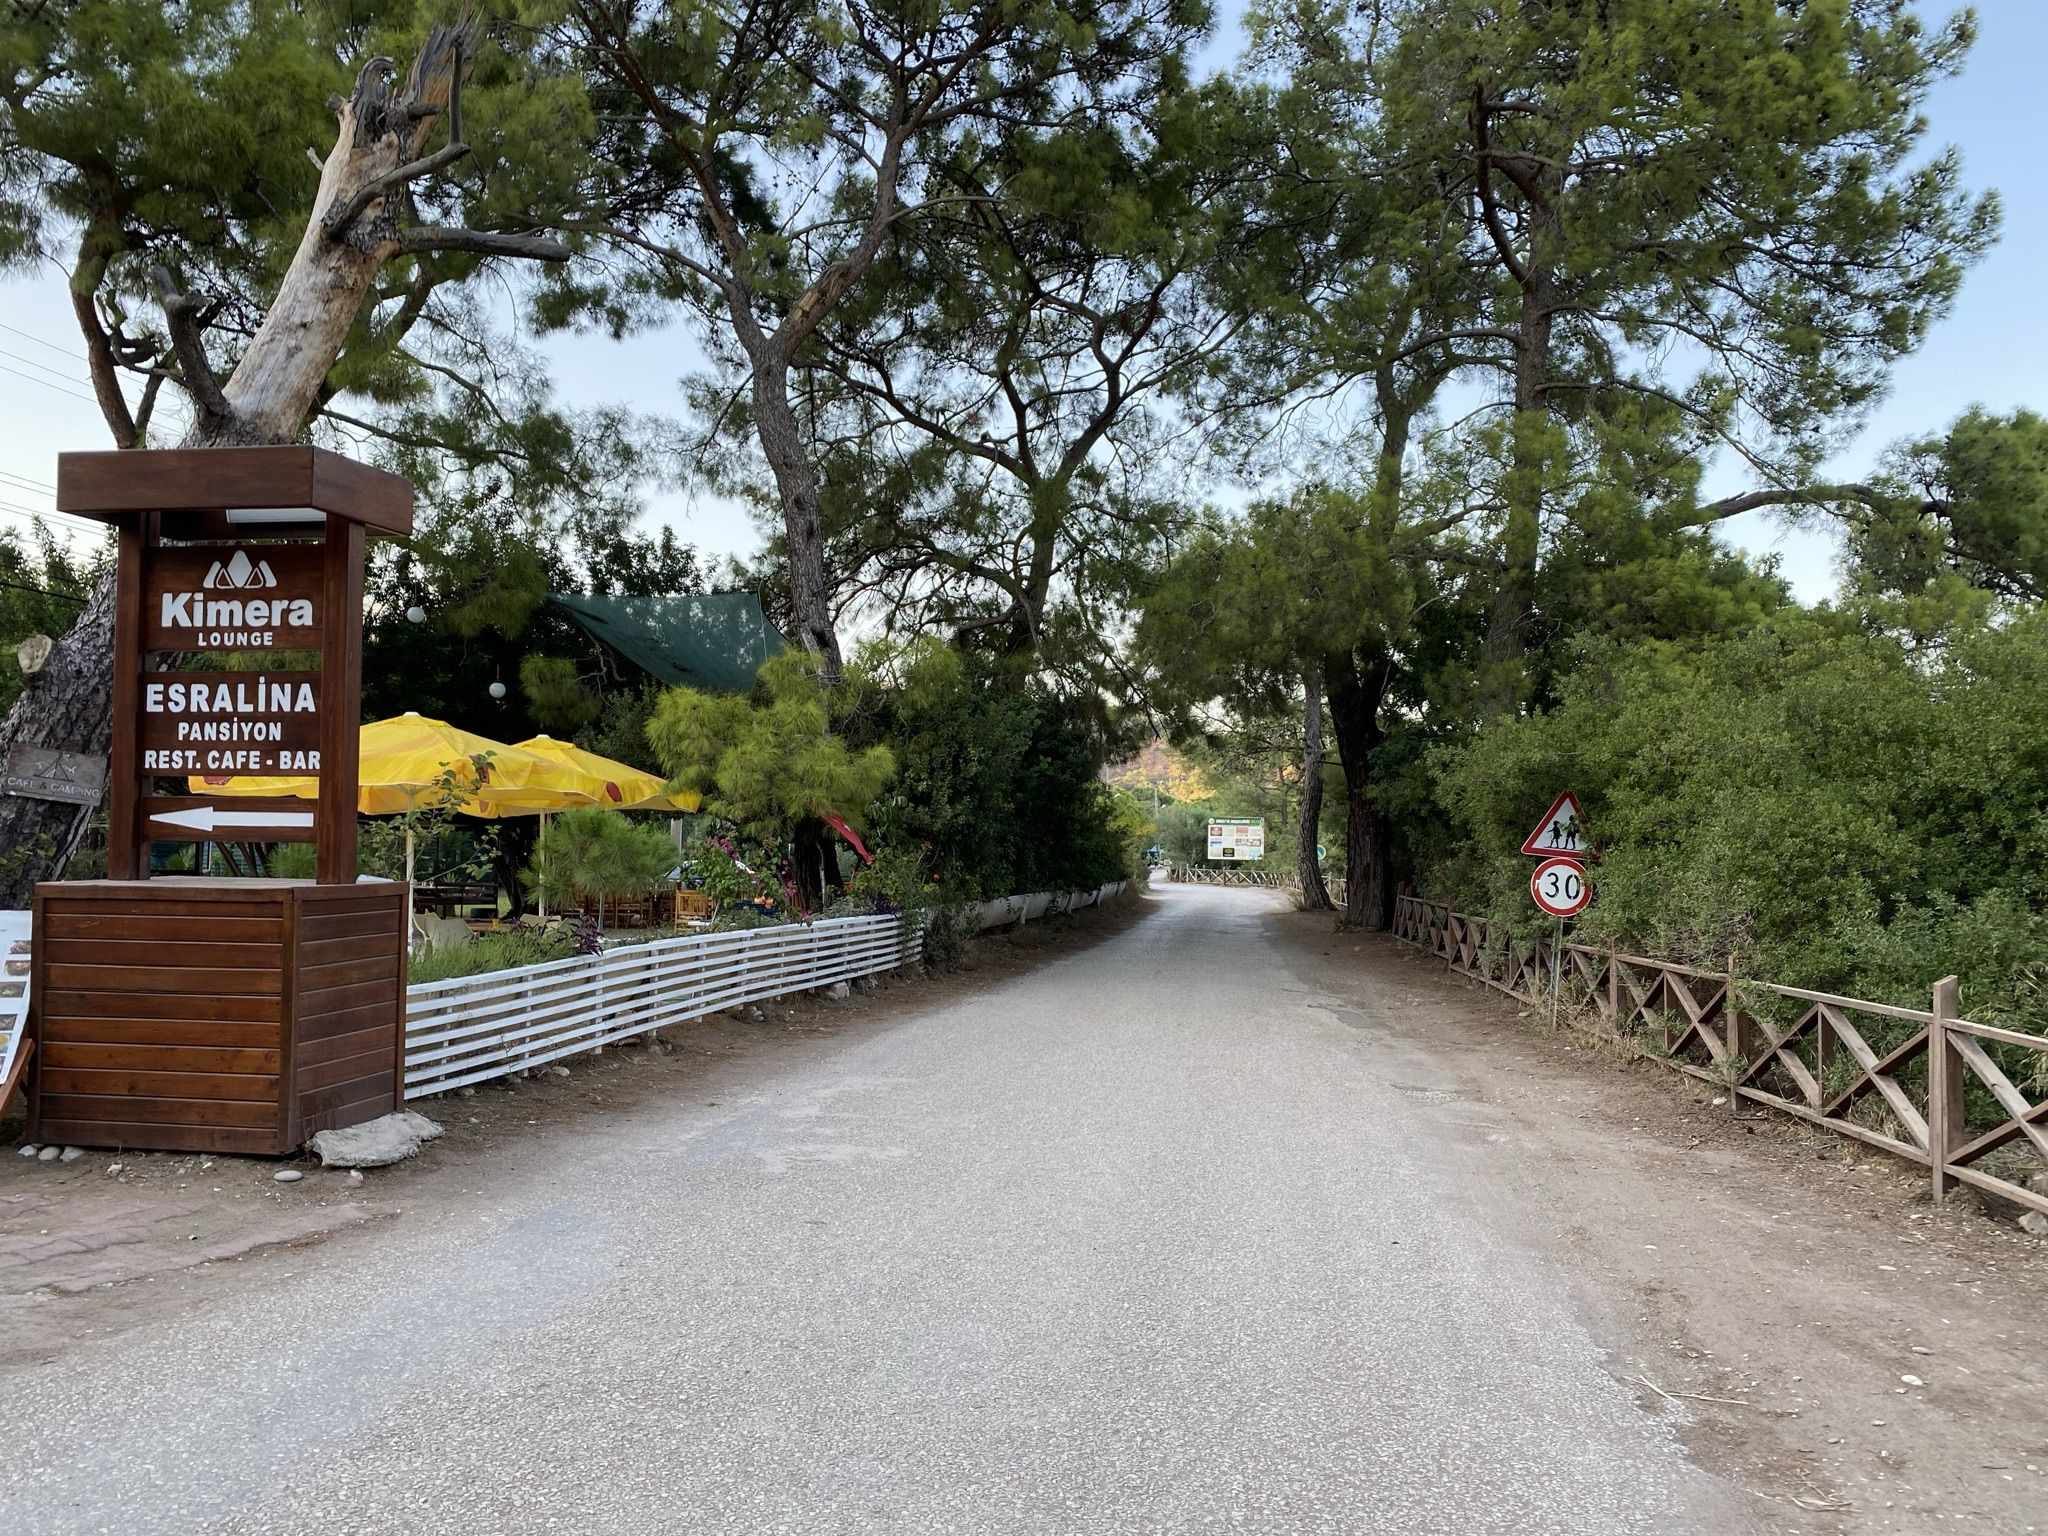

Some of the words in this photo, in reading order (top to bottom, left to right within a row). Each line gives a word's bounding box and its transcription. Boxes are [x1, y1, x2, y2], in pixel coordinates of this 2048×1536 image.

[161, 592, 313, 627] Kimera
[198, 632, 273, 646] LOUNGE
[146, 676, 316, 713] ESRALİNA
[178, 717, 281, 741] PANSİYON
[144, 750, 201, 769] REST.
[207, 750, 260, 769] CAFE
[279, 751, 320, 769] BAR
[50, 783, 100, 797] CAMPING
[1545, 872, 1580, 900] 30
